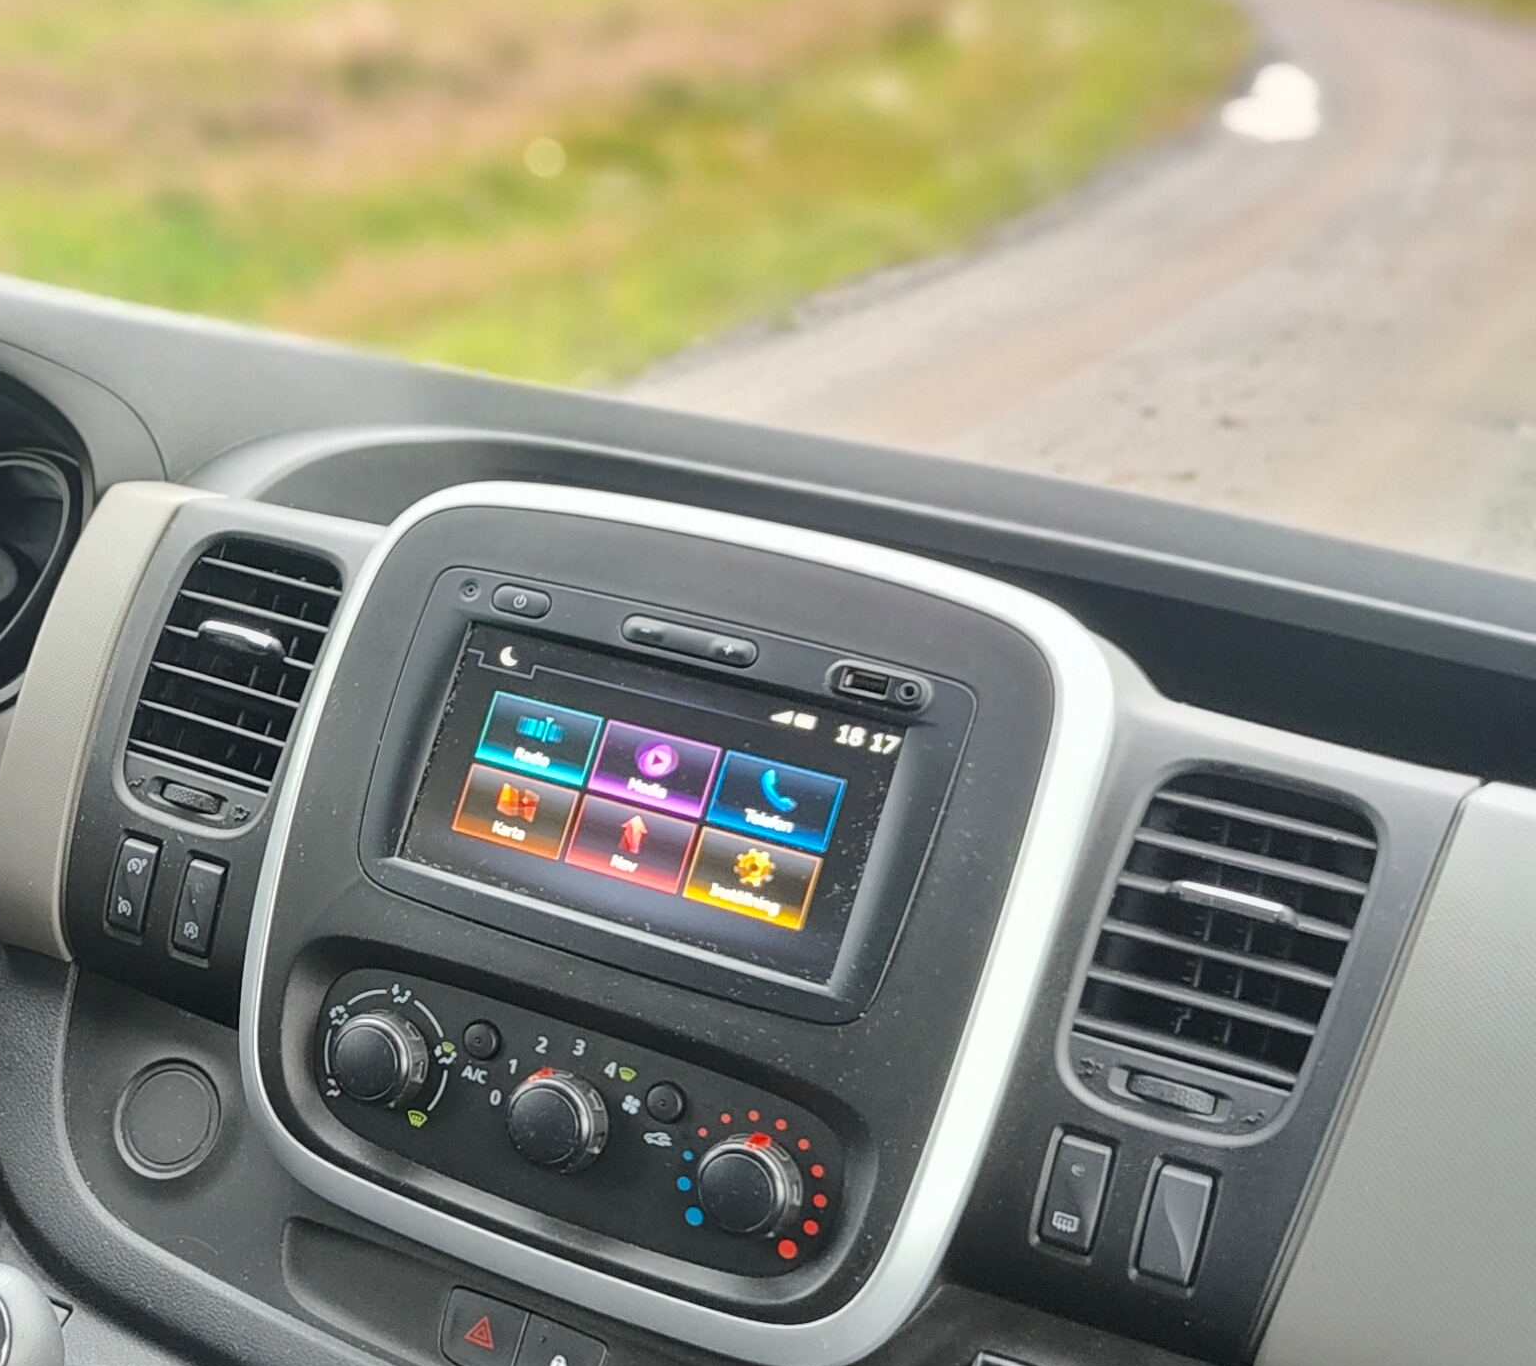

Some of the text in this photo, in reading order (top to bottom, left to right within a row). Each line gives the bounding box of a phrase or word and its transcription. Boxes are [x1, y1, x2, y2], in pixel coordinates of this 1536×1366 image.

[514, 746, 550, 768] Radio
[627, 777, 668, 799] Media
[745, 808, 794, 833] Telefon
[492, 820, 525, 841] Karta
[610, 853, 638, 873] Nav
[534, 1036, 549, 1054] 2
[572, 1038, 586, 1056] 3
[461, 1065, 488, 1084] A/C
[508, 1058, 518, 1075] 1
[603, 1061, 617, 1079] 4
[489, 1089, 502, 1106] 0
